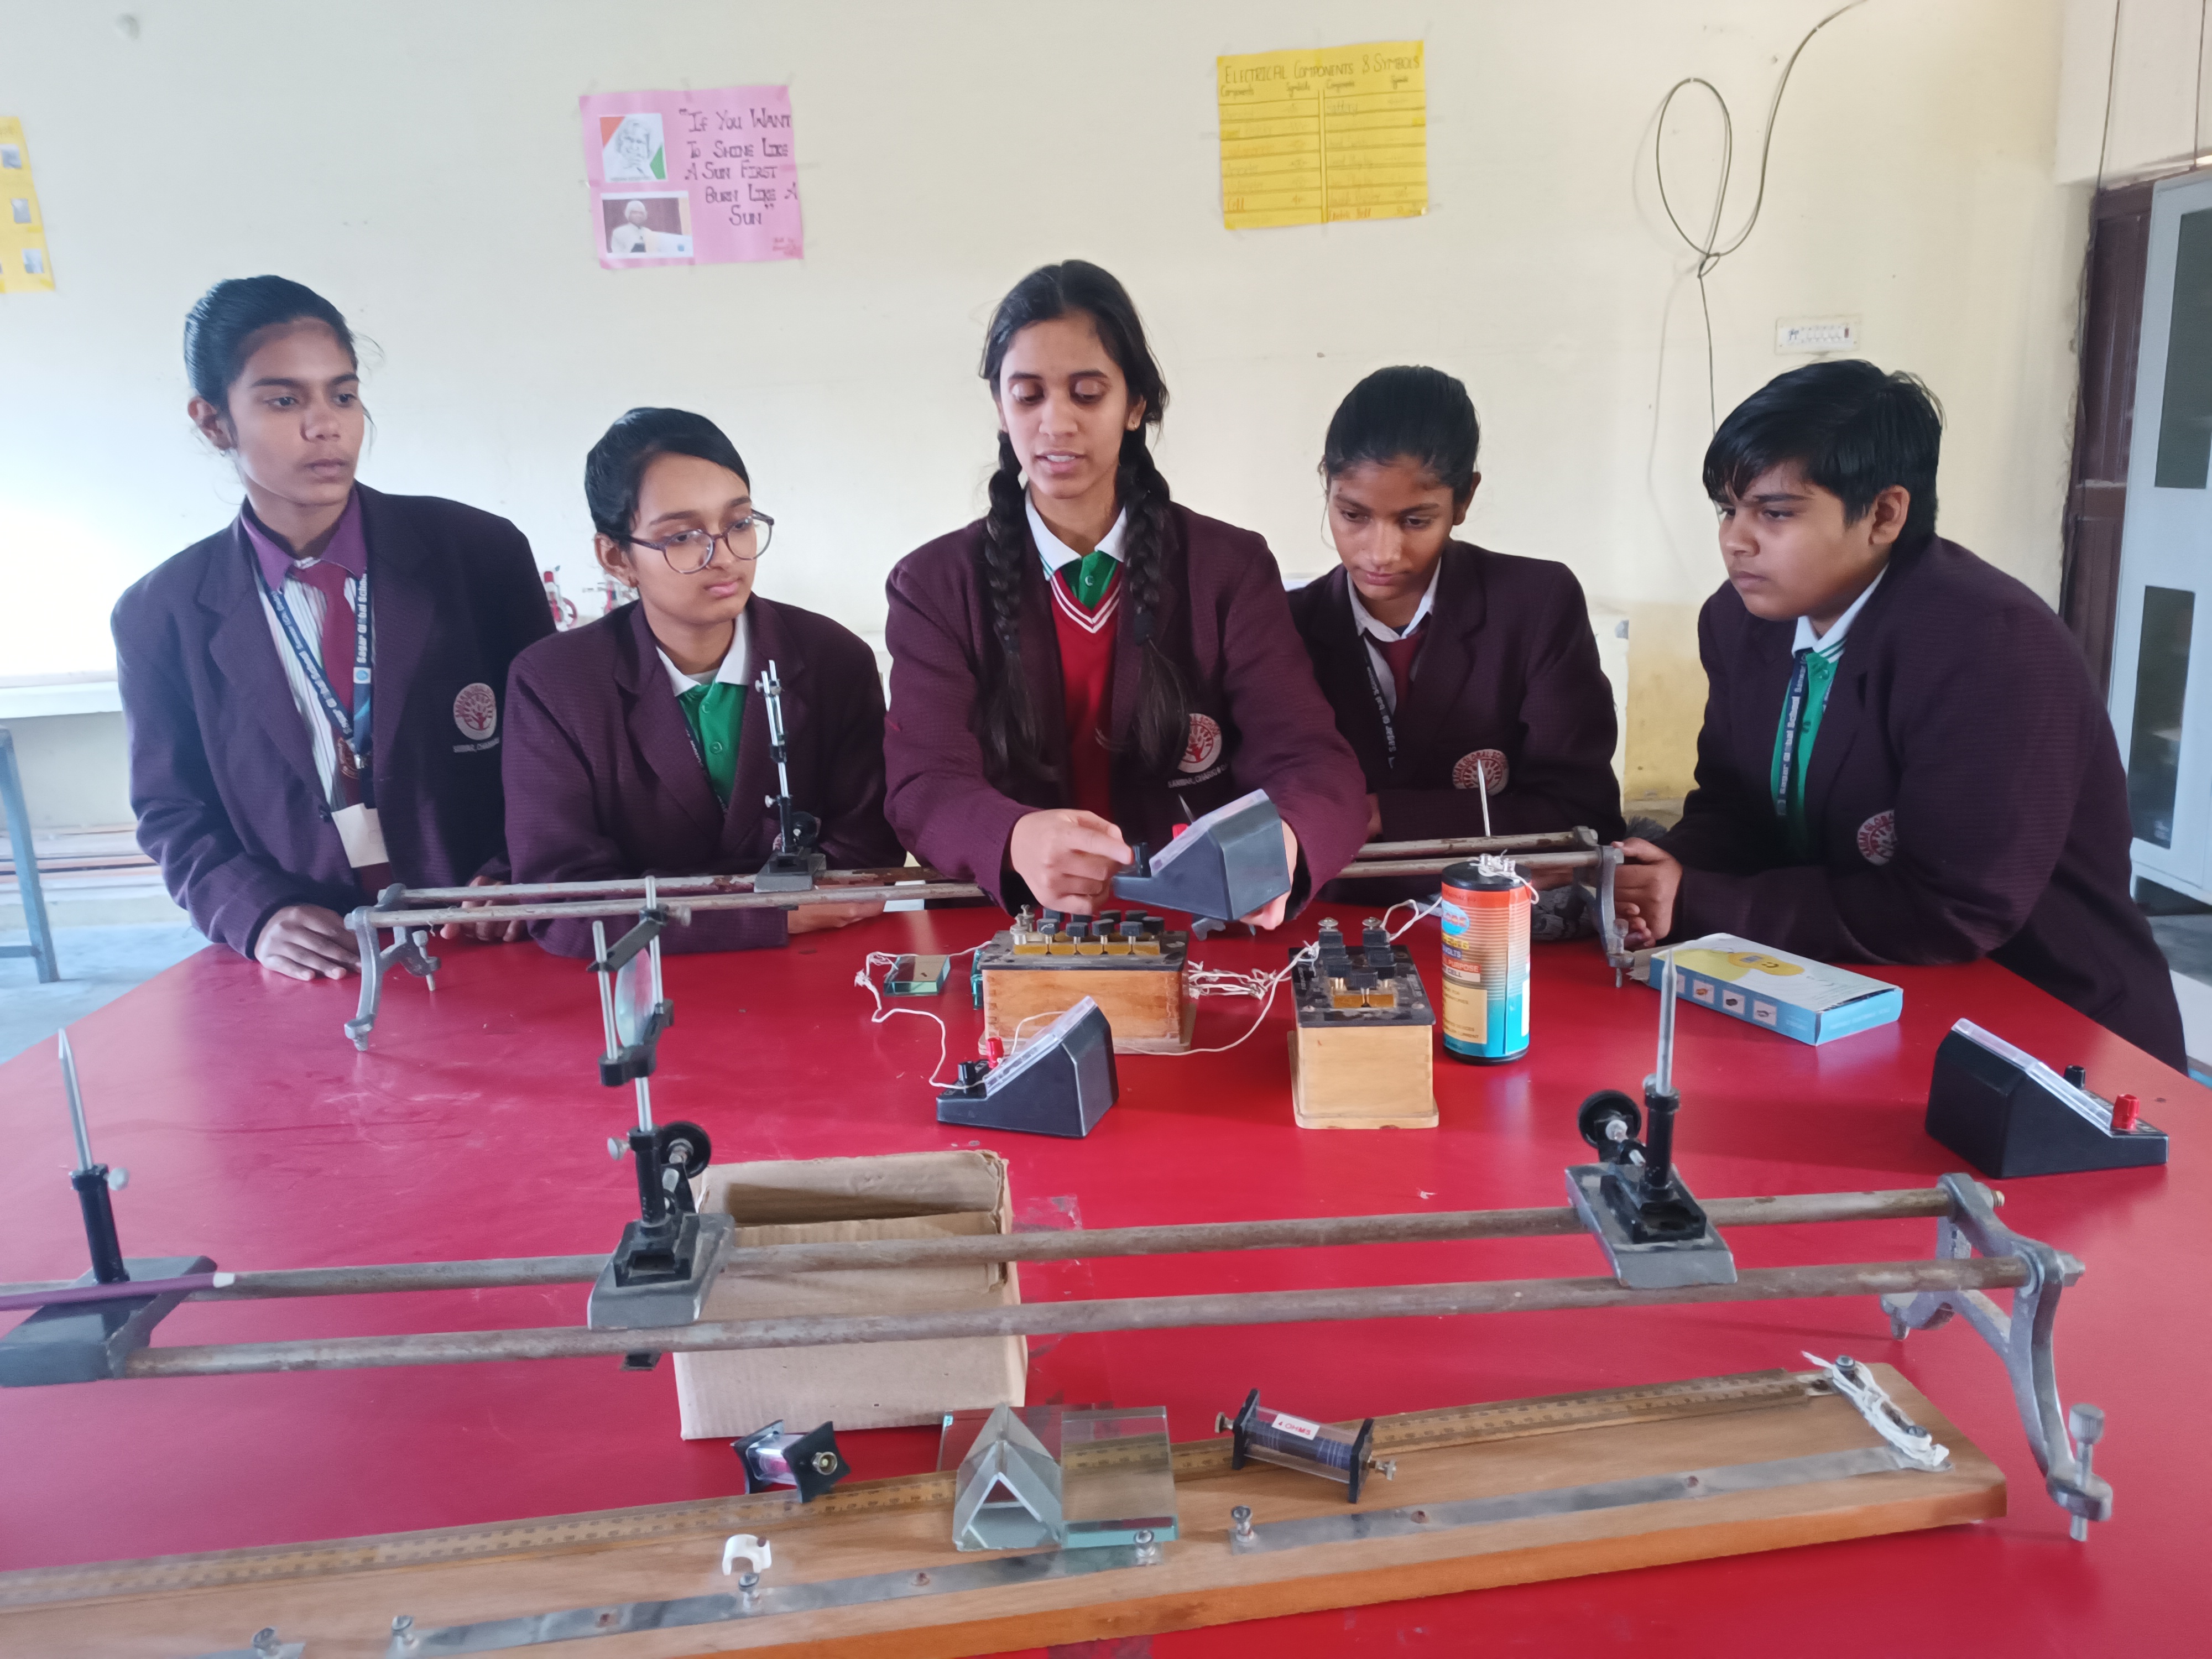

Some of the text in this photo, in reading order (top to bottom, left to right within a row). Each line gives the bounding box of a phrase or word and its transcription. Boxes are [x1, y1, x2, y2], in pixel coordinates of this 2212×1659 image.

[1225, 65, 1287, 84] ELECTRICAL
[1294, 60, 1354, 79] COMPONENTS
[1373, 53, 1420, 72] SYMBOLS
[685, 163, 698, 180] A
[741, 159, 778, 179] FIRST
[784, 182, 798, 200] A
[1448, 959, 1479, 972] PURPOSE
[1448, 968, 1462, 977] CELL
[1285, 1423, 1311, 1435] OHMS
